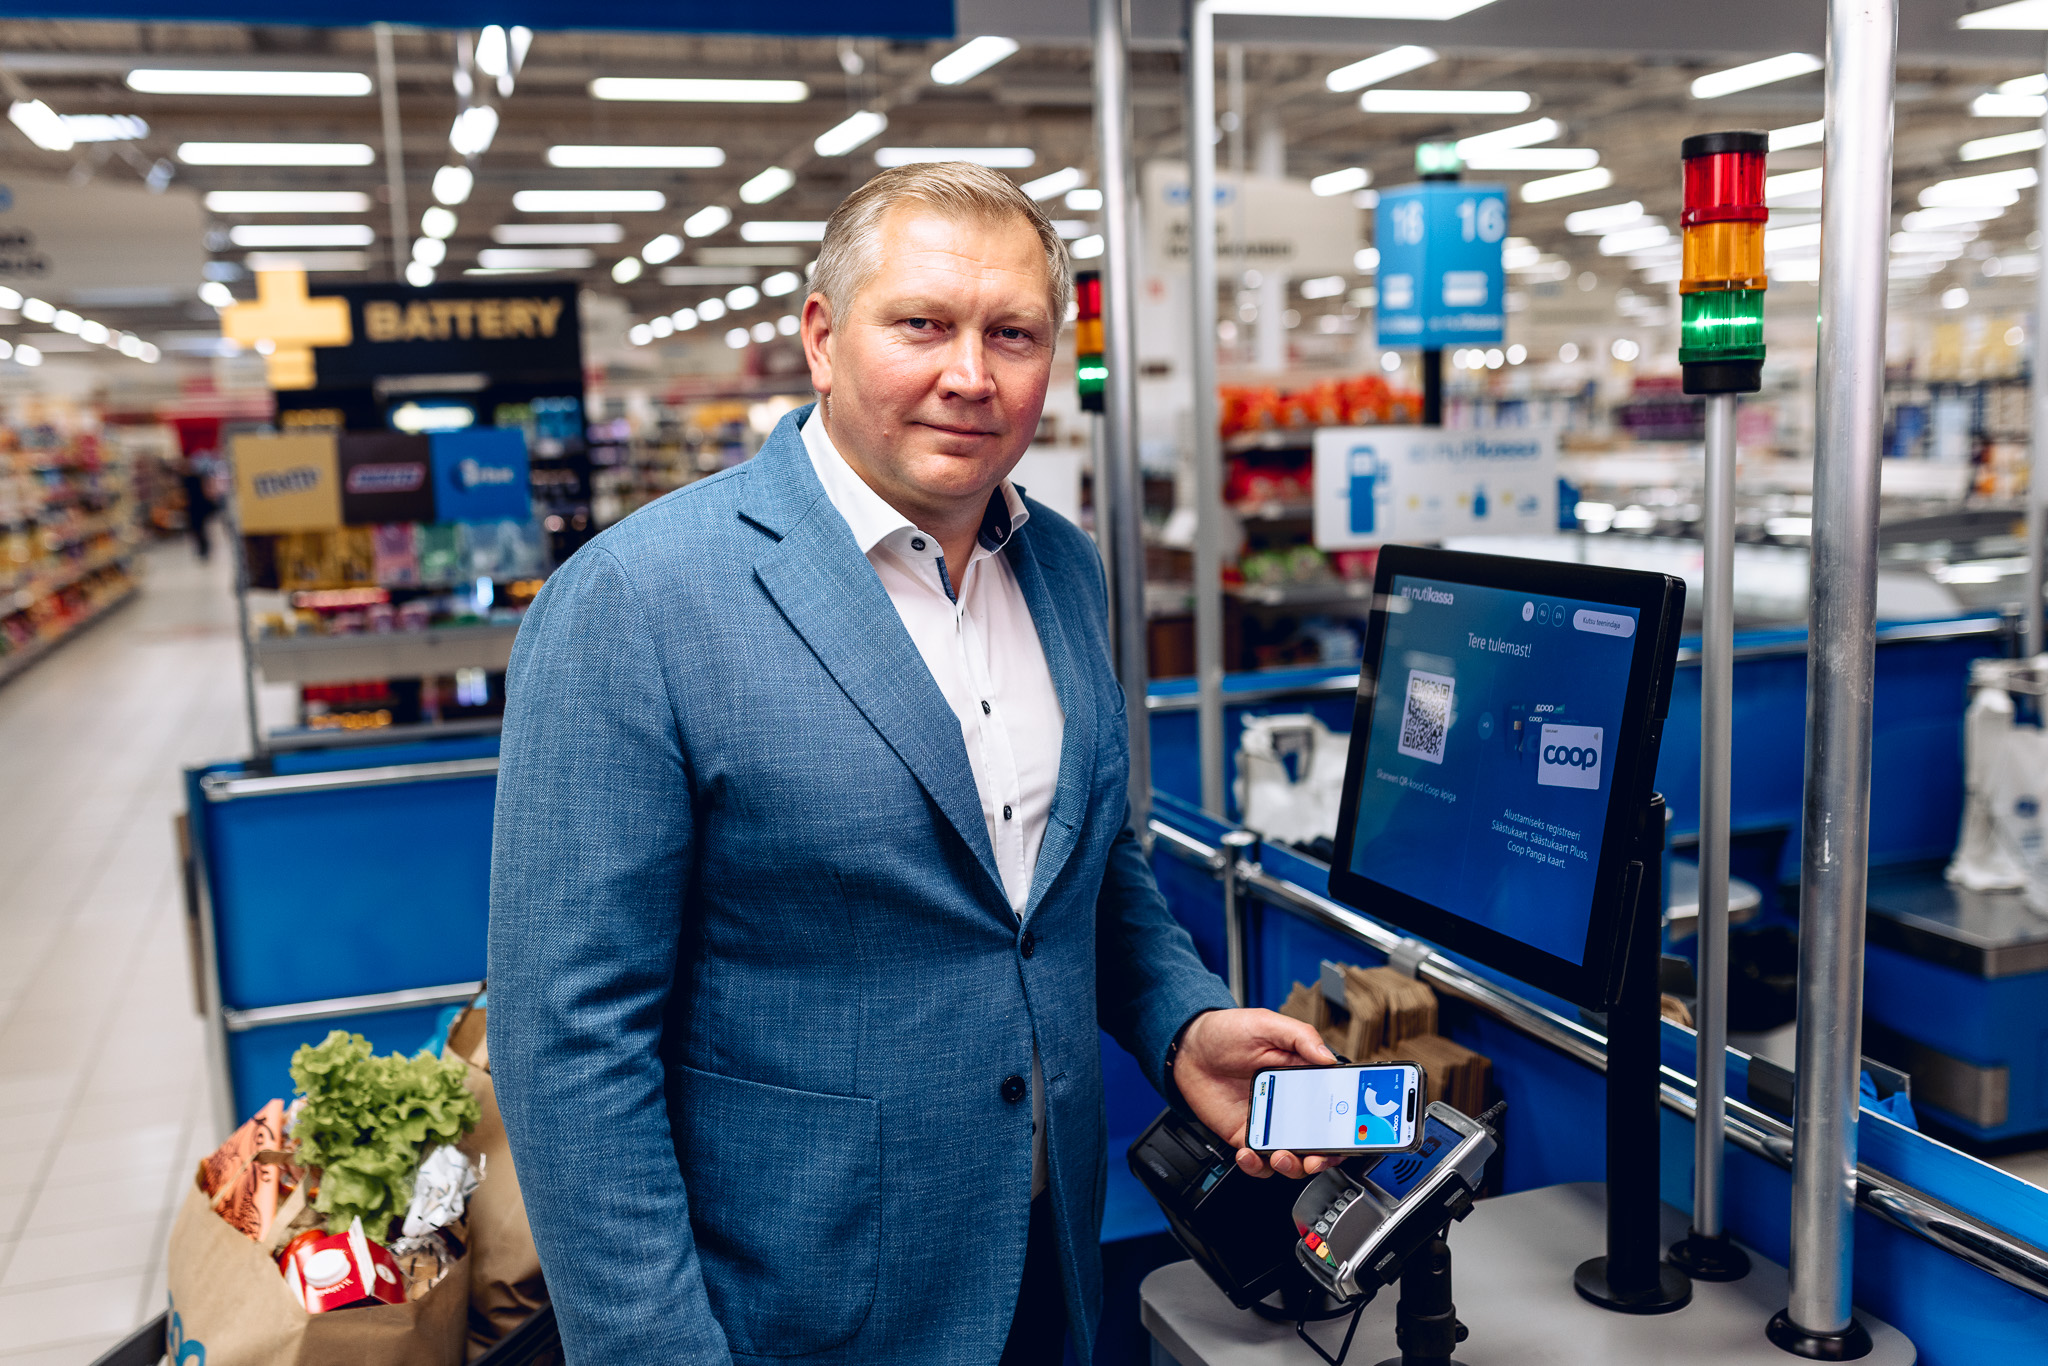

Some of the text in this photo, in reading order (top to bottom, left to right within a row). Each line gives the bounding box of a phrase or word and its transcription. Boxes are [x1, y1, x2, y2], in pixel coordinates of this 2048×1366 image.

[1456, 197, 1505, 243] 16
[363, 297, 564, 342] BATTERY
[1412, 586, 1453, 605] nutikassa
[1583, 617, 1621, 630] Kutsu teenindaja
[1468, 632, 1532, 658] Tere tulemast!
[1544, 744, 1598, 770] coop
[1424, 784, 1440, 798] Coop
[1503, 808, 1581, 842] Alustamiseks registreeri
[1492, 820, 1588, 862] Säästukaart, Säästukaart Pluss,
[1507, 840, 1566, 868] Coop Panga kaart.
